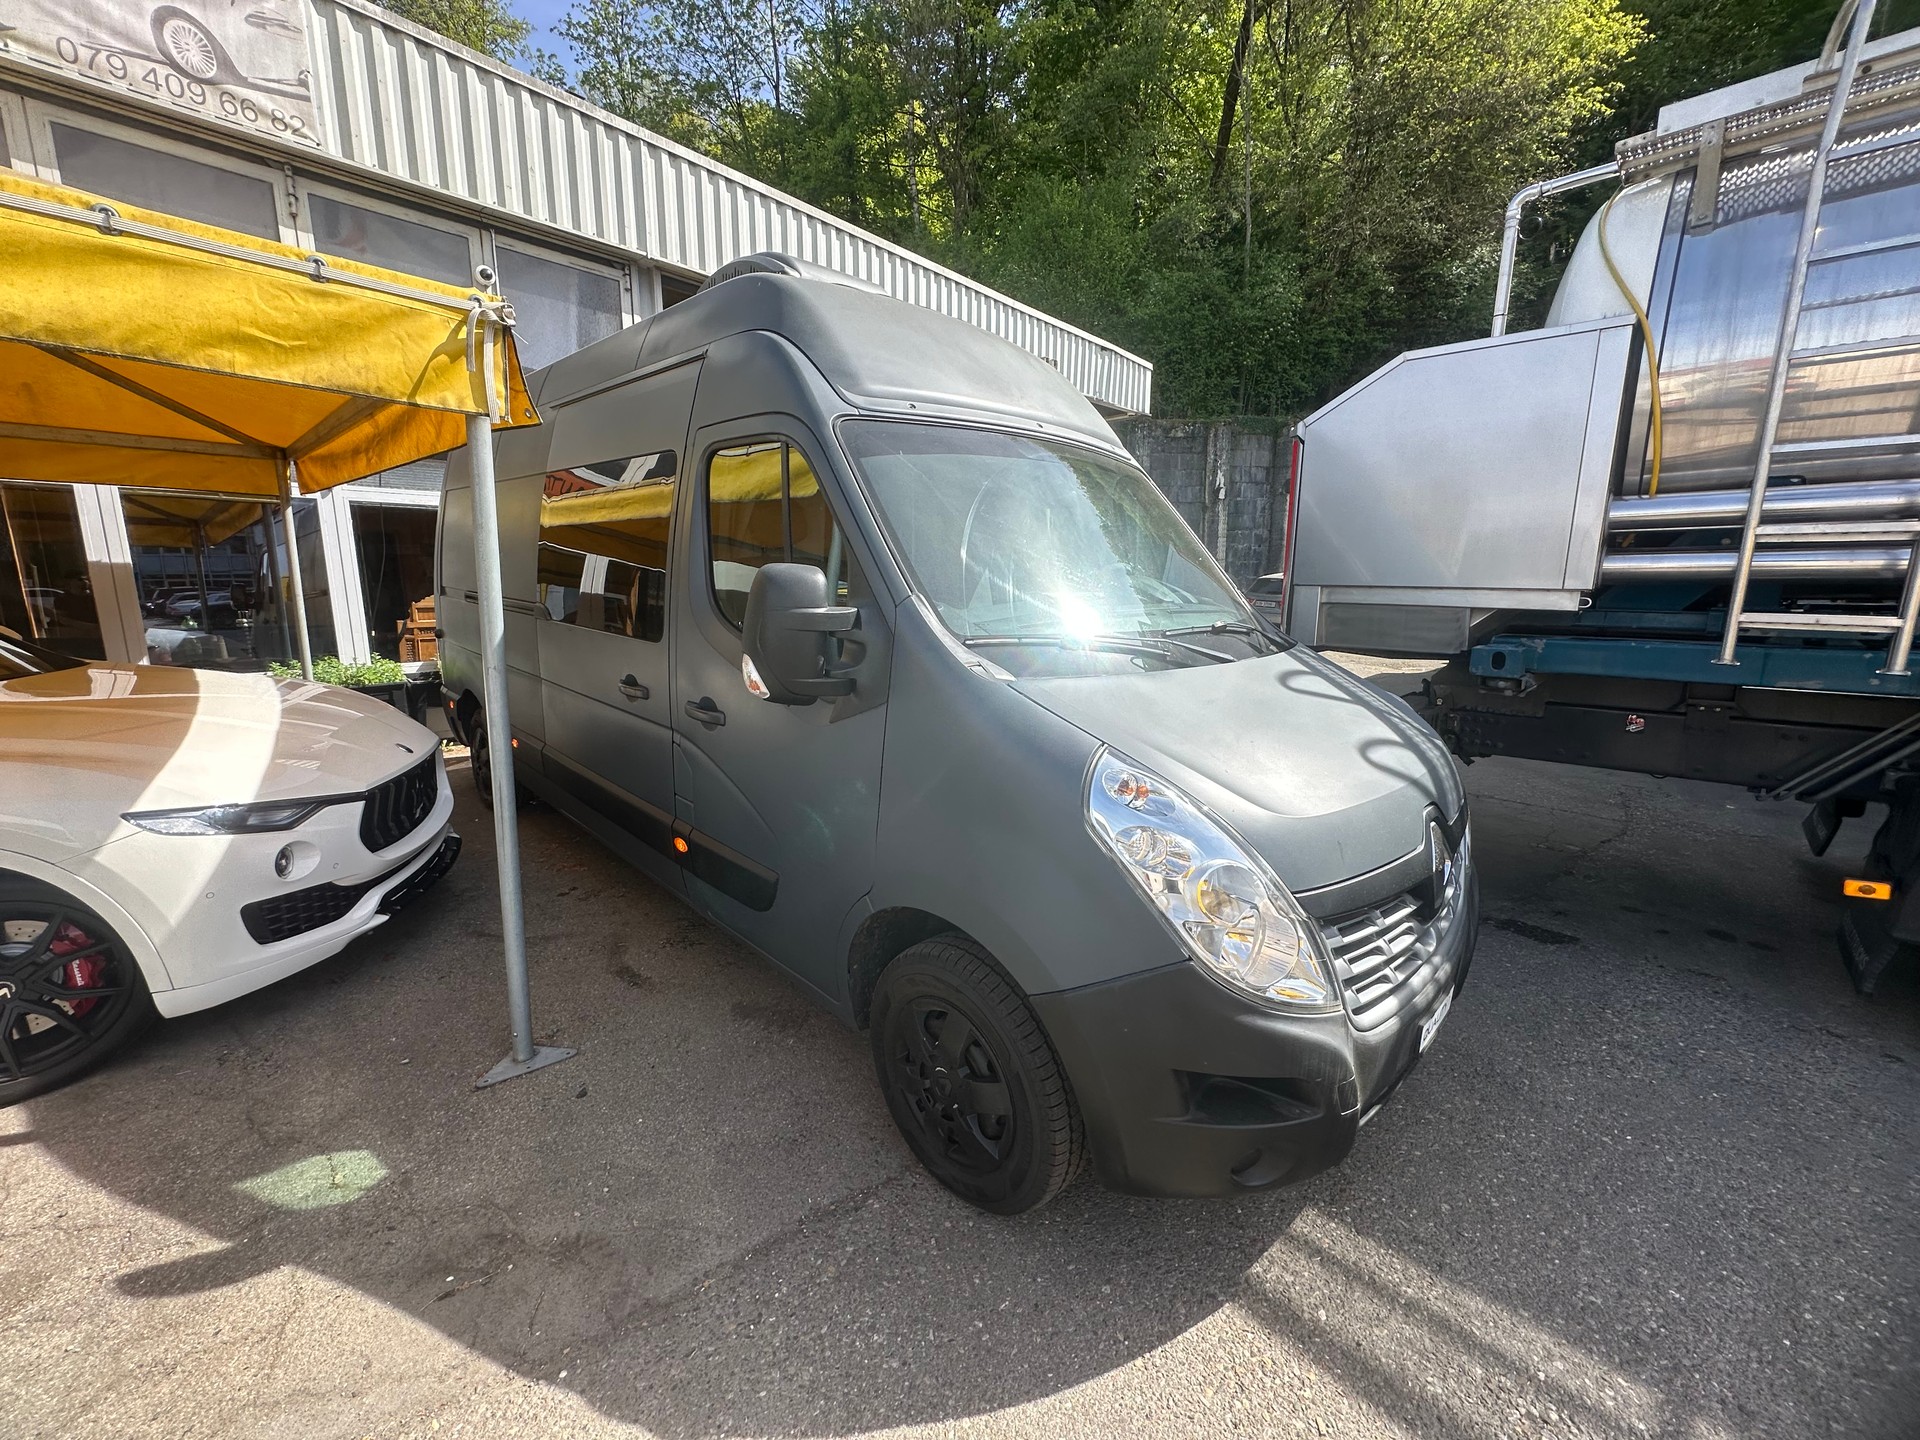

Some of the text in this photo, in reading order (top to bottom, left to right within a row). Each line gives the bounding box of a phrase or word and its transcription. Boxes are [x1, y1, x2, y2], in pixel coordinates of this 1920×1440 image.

[56, 36, 307, 139] 079 409 66 82
